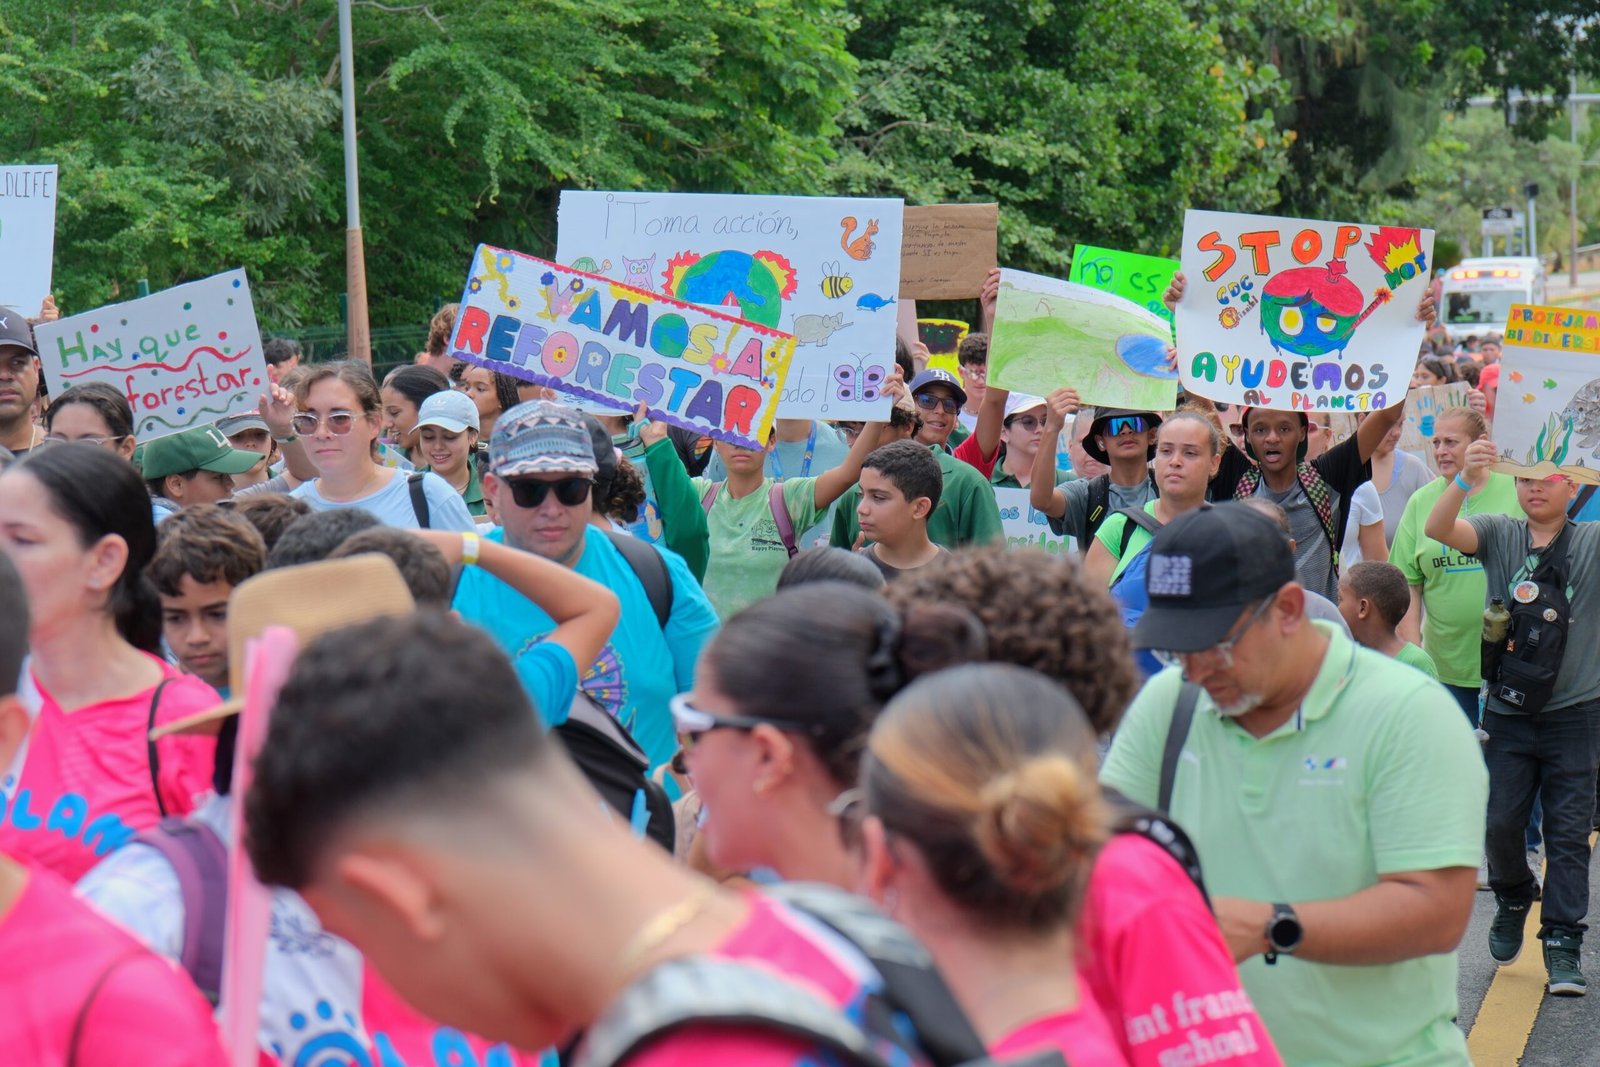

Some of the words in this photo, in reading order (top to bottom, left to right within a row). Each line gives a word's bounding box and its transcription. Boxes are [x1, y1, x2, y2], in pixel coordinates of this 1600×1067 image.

[0, 171, 53, 198] DLIFE
[713, 210, 800, 240] acción,
[1197, 225, 1362, 282] STOP
[1217, 274, 1254, 305] CDC
[543, 272, 720, 366] VAMOS
[729, 337, 763, 382] A
[1512, 308, 1600, 331] PROTEJAM
[139, 323, 201, 362] que
[1507, 328, 1600, 352] BIODIVERSI
[454, 306, 762, 436] REFORESTAR
[1191, 351, 1389, 391] AYUDEMOS
[779, 362, 831, 413] odo!
[1243, 389, 1271, 405] AL
[1291, 391, 1387, 411] PLANETA
[1432, 556, 1456, 569] DEL
